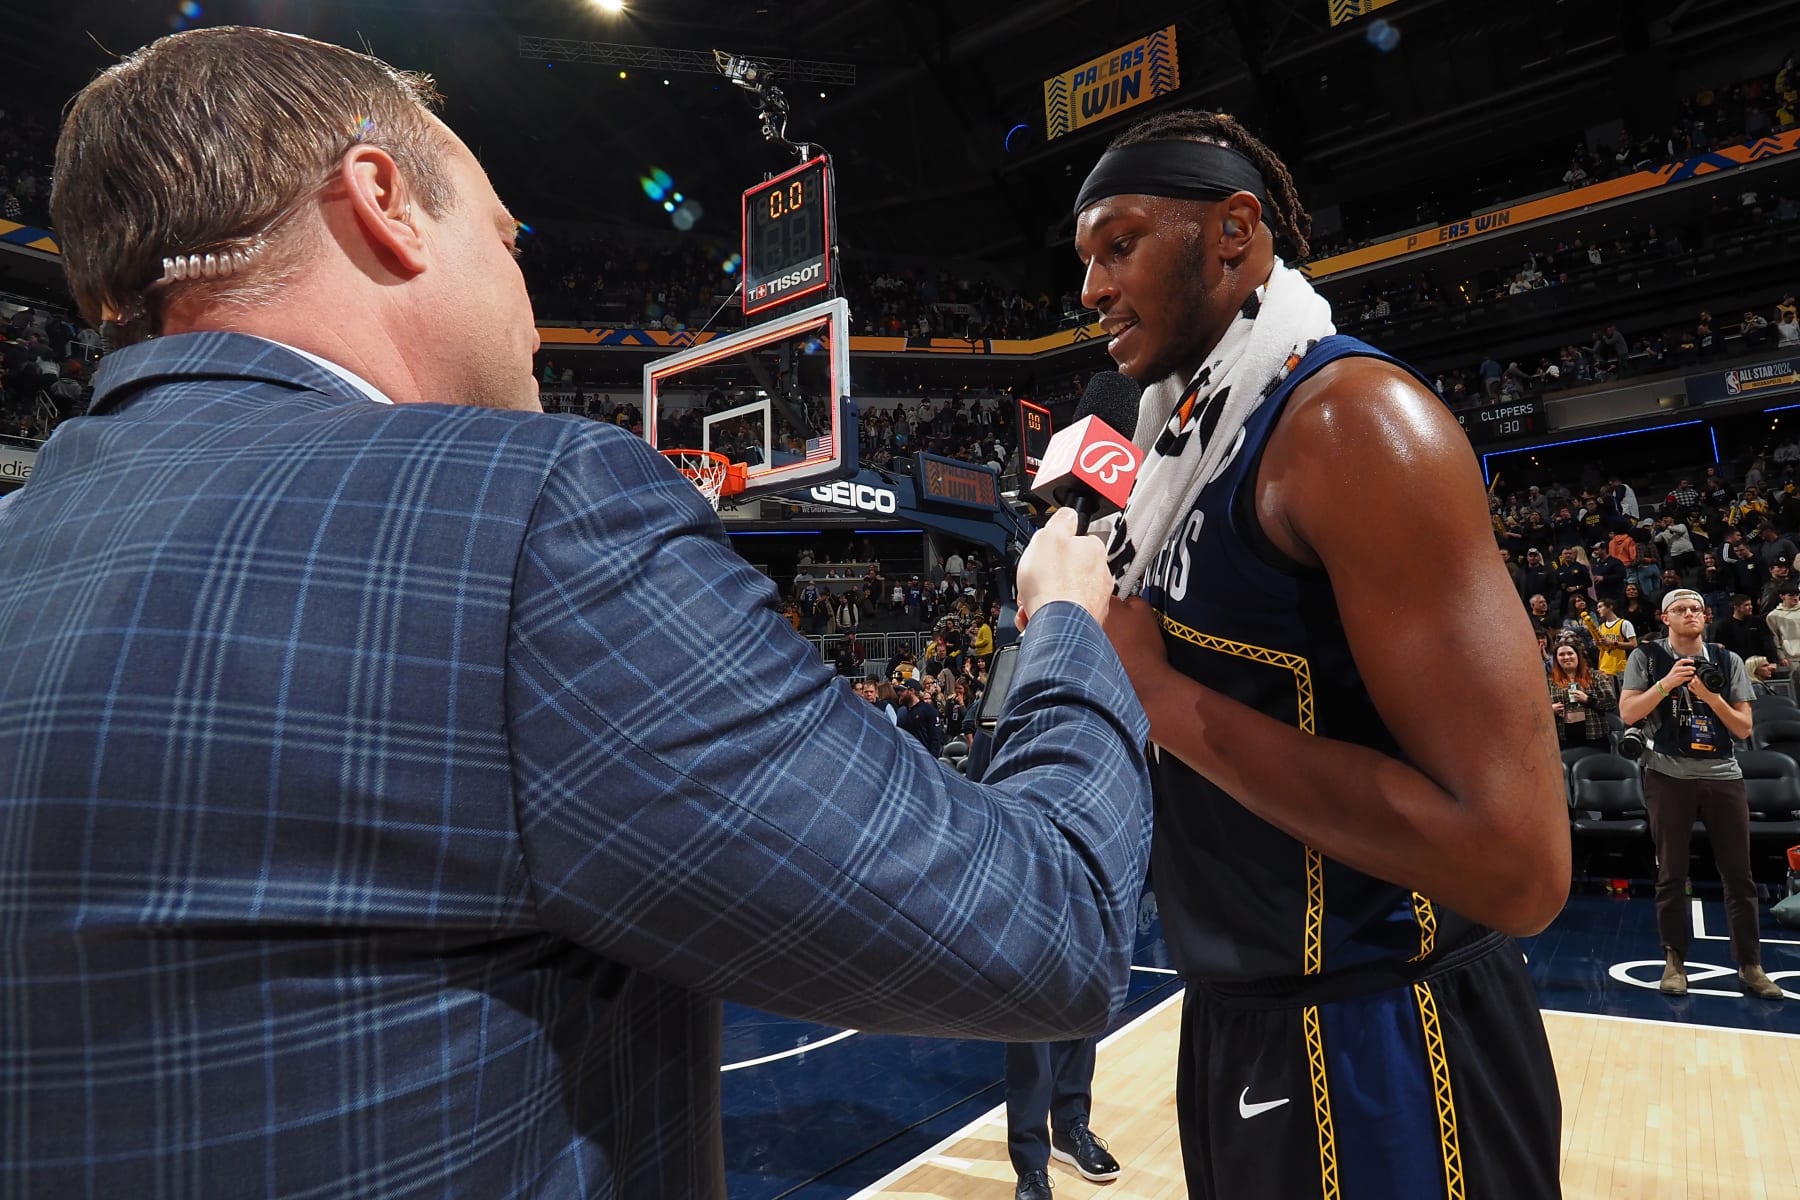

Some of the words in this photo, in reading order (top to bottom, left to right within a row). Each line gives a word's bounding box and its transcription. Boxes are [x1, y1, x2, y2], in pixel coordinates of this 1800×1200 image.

[1073, 44, 1145, 92] PACERS
[1081, 68, 1142, 119] WIN
[770, 181, 802, 218] 0.0
[1407, 221, 1469, 250] PERS
[1475, 210, 1510, 231] WIN
[768, 263, 822, 294] TISSOT
[1773, 362, 1792, 376] 2024
[1481, 403, 1534, 421] CLIPPERS
[1499, 420, 1520, 434] 130
[810, 480, 896, 514] GEICO
